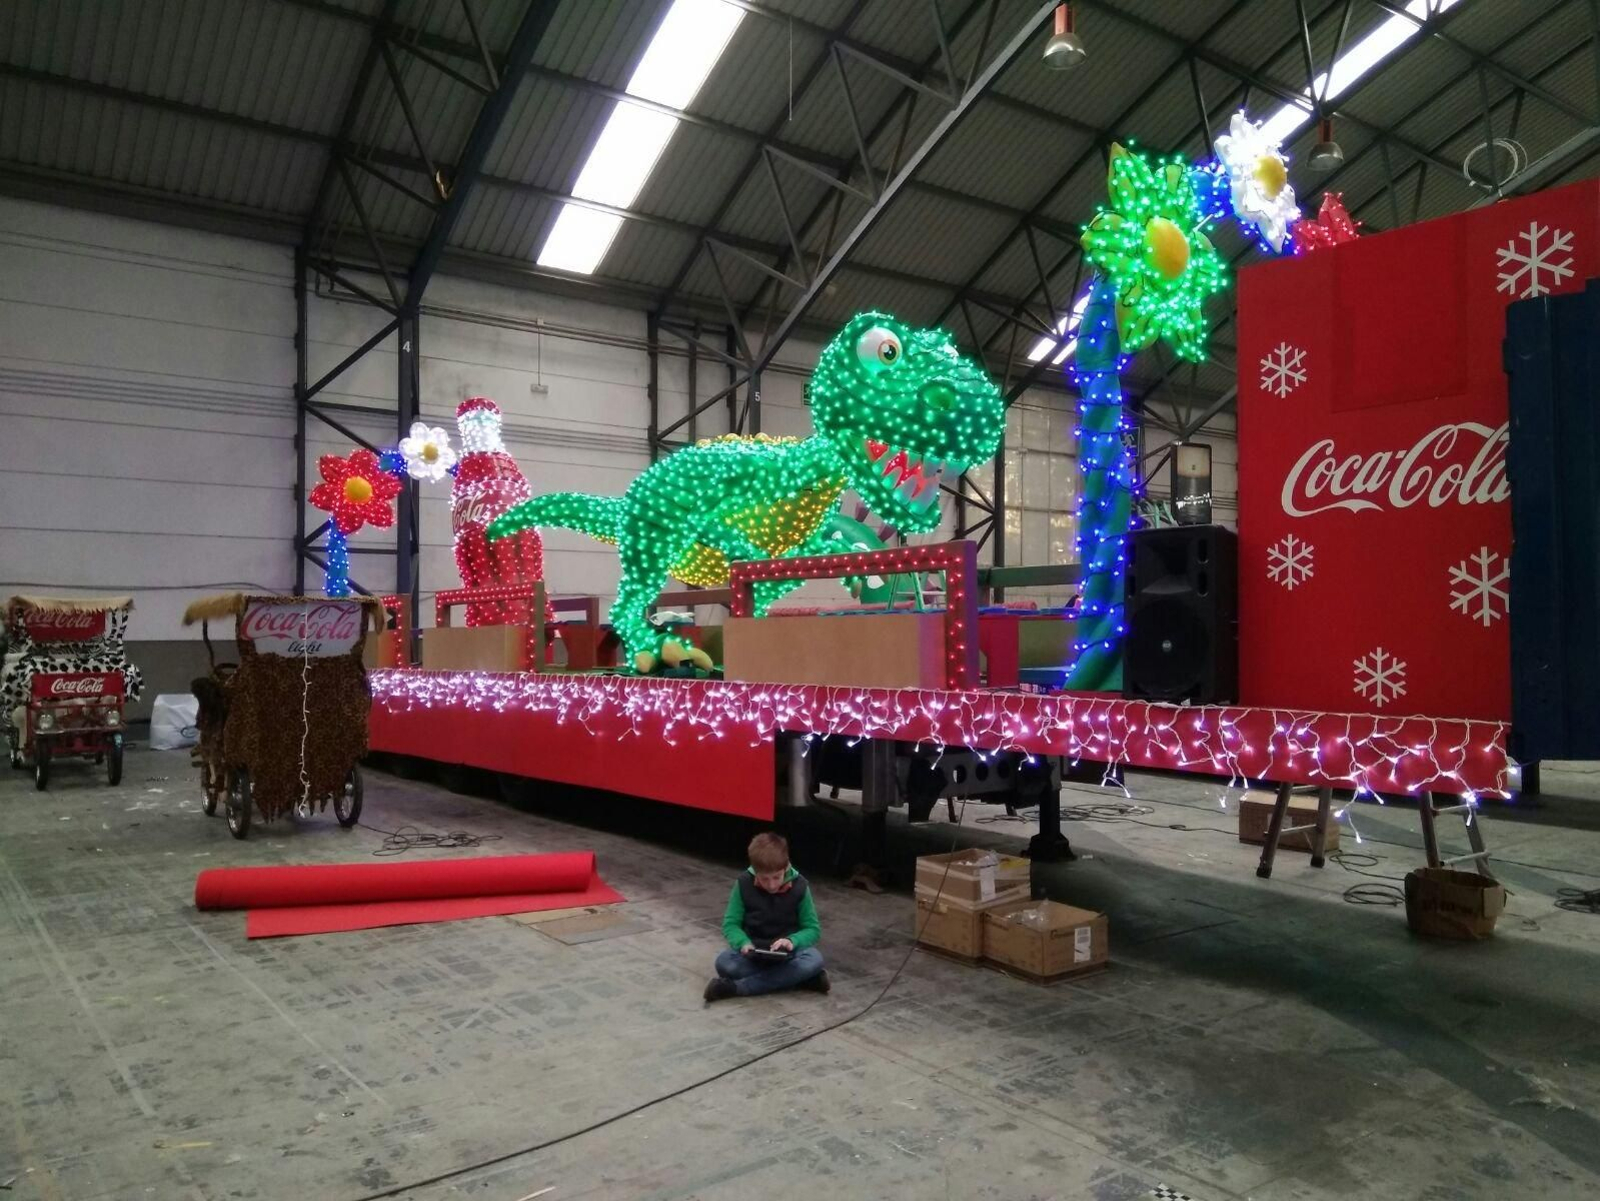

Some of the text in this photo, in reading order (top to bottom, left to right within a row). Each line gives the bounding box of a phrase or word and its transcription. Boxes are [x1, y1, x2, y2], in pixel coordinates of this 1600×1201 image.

[402, 340, 411, 353] 4
[754, 391, 761, 402] 5
[1281, 421, 1511, 517] Coca-Cola
[24, 608, 96, 629] CocaCola
[239, 603, 361, 640] Coca-Cola
[50, 677, 105, 694] Coca-Cola
